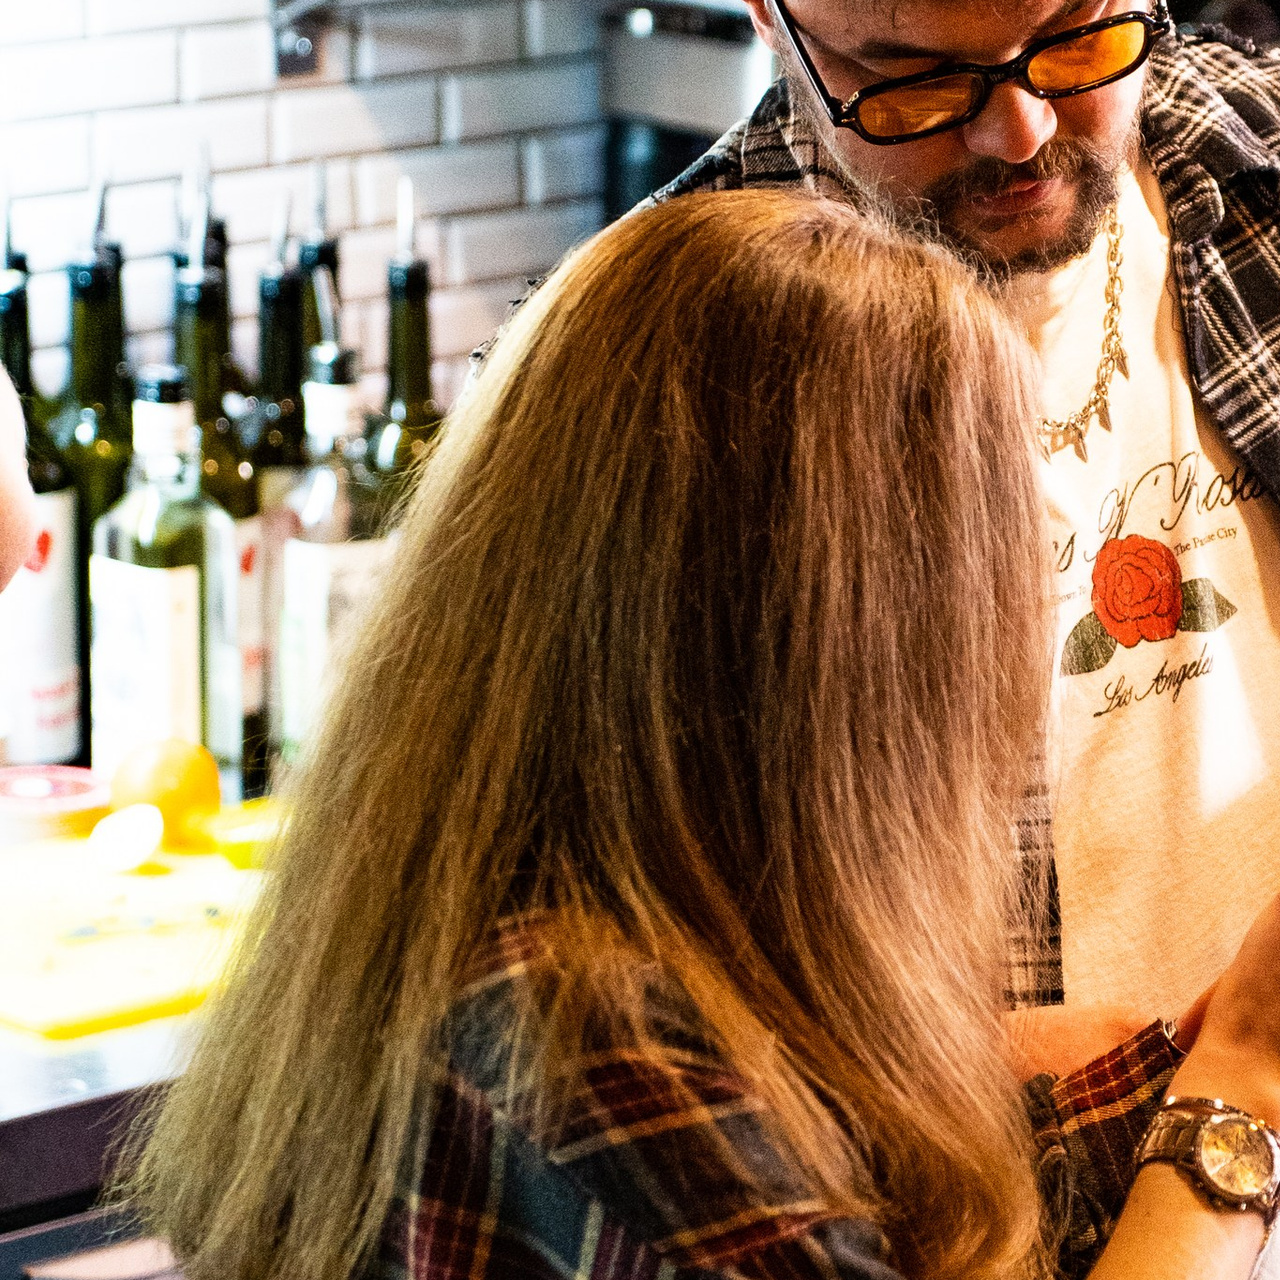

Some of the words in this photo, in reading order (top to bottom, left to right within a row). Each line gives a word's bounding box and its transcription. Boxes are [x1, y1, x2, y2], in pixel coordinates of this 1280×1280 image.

[1173, 542, 1191, 557] The
[1217, 526, 1238, 540] City
[1093, 674, 1134, 718] Los
[1135, 642, 1214, 704] Angeles
